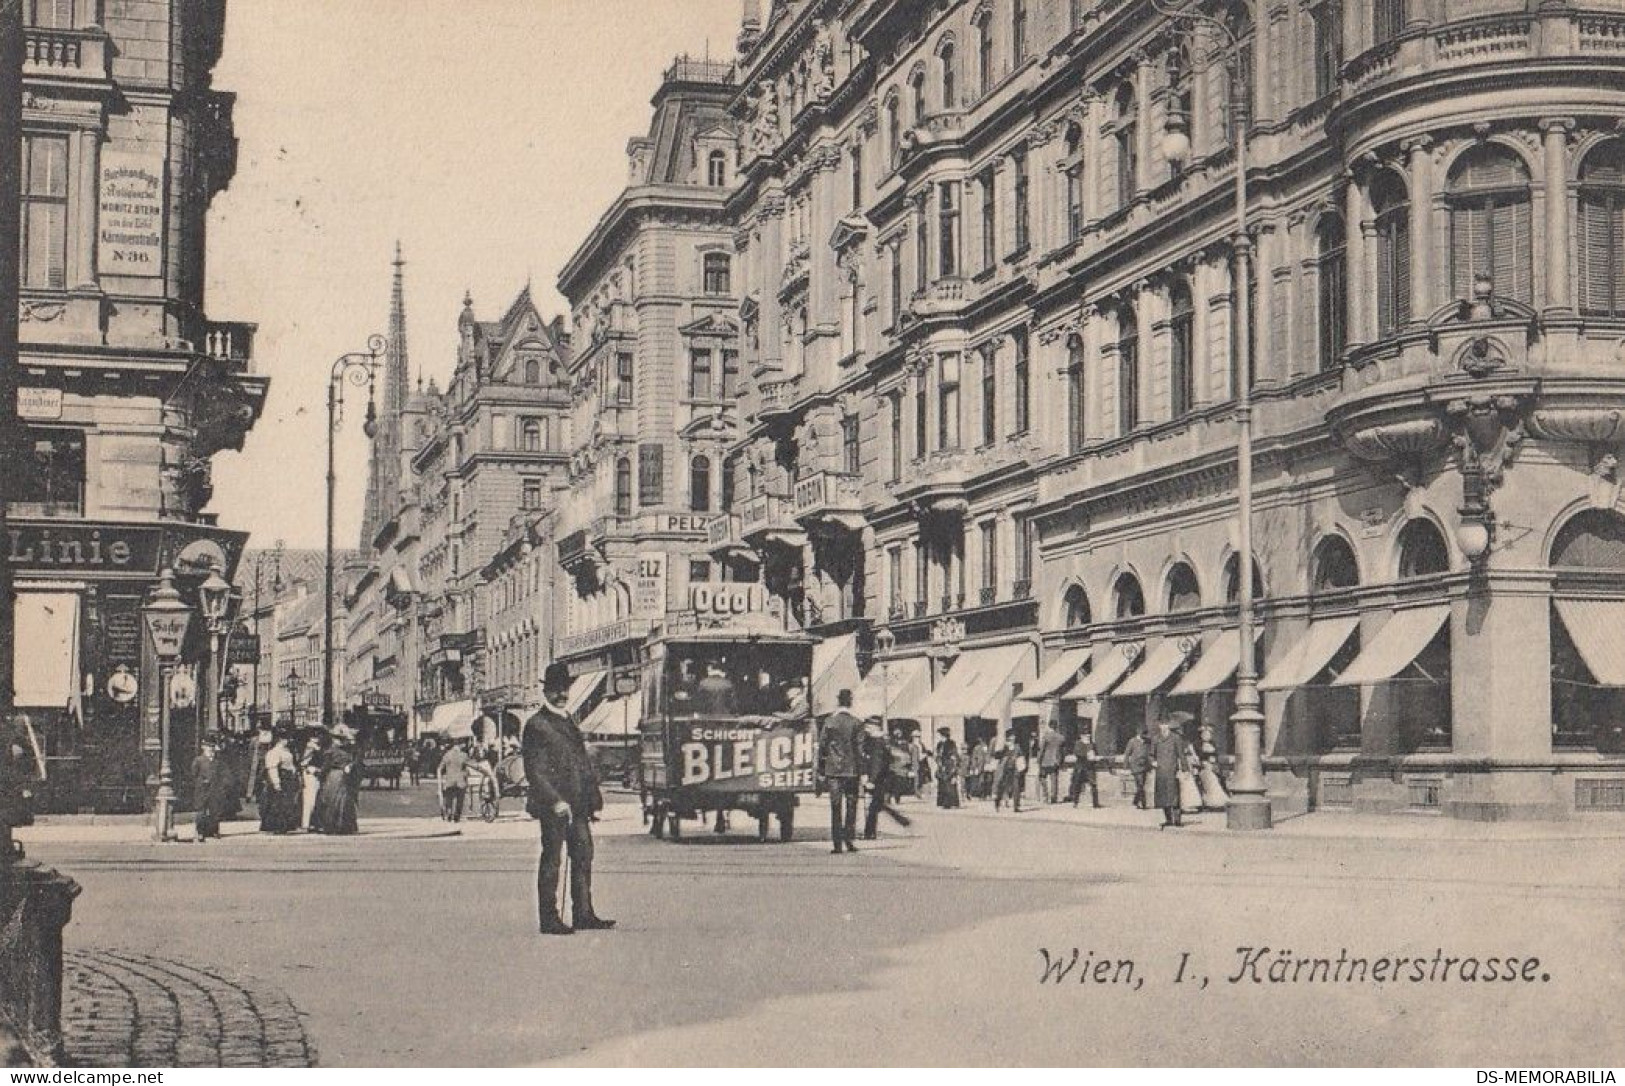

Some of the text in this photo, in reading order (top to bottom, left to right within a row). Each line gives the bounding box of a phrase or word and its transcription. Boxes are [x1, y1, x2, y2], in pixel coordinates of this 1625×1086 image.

[101, 203, 160, 216] MORITZ STERN
[668, 515, 711, 532] PELZ
[7, 529, 131, 564] Linie
[681, 732, 813, 786] BLEICH
[759, 768, 813, 788] SEIFE
